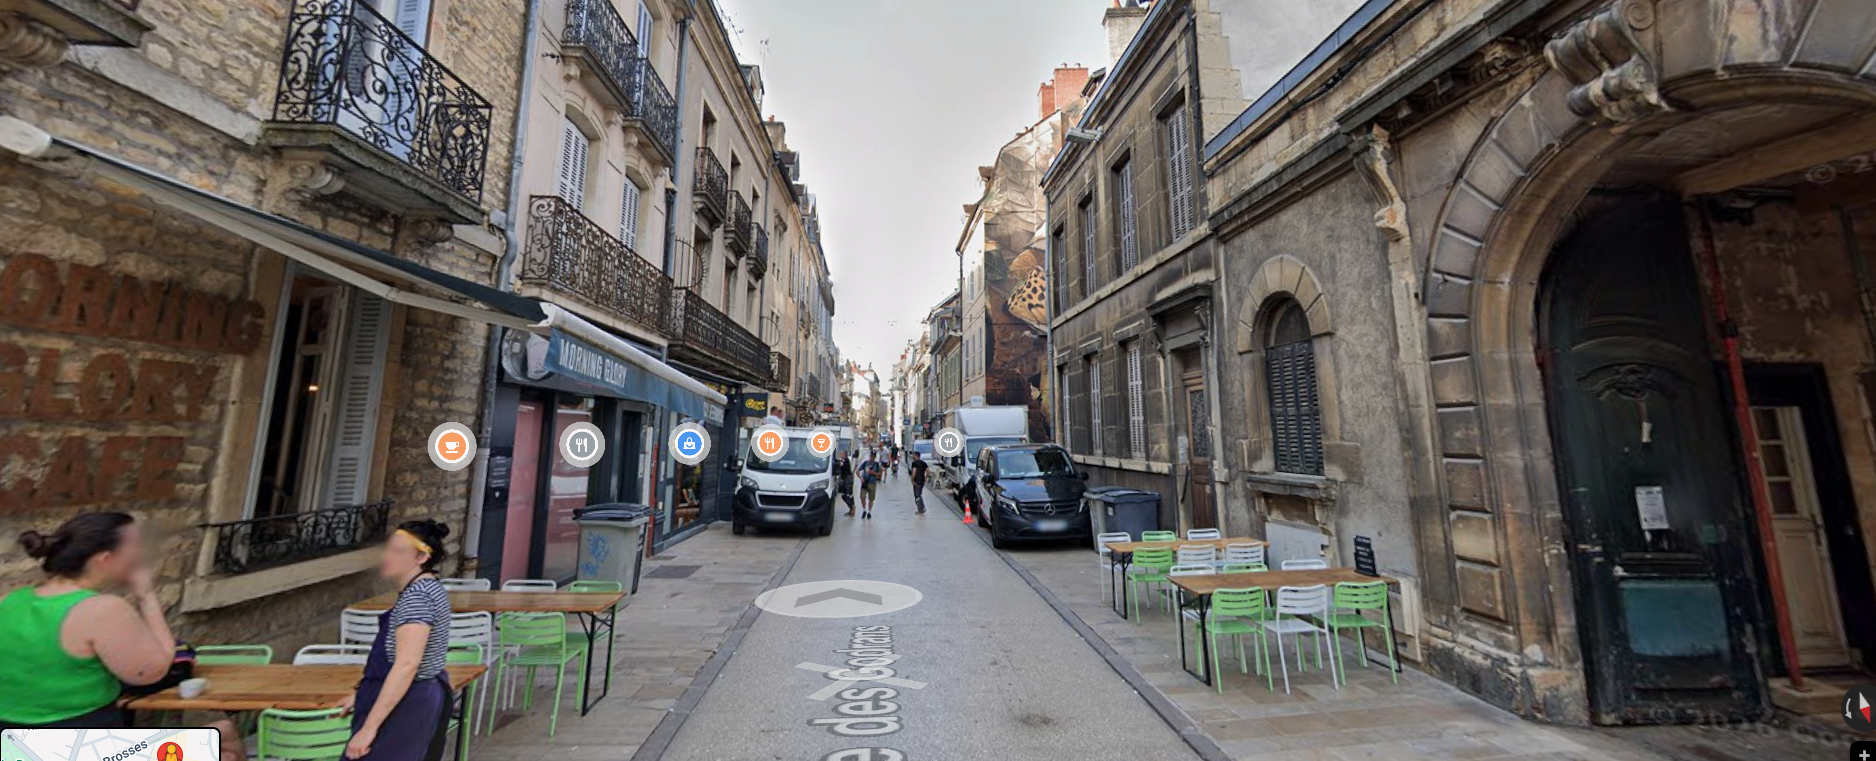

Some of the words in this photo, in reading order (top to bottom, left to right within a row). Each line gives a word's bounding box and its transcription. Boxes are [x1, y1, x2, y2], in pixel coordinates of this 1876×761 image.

[0, 251, 265, 355] ORNING
[559, 338, 603, 380] MORNING
[604, 358, 627, 388] GLORY
